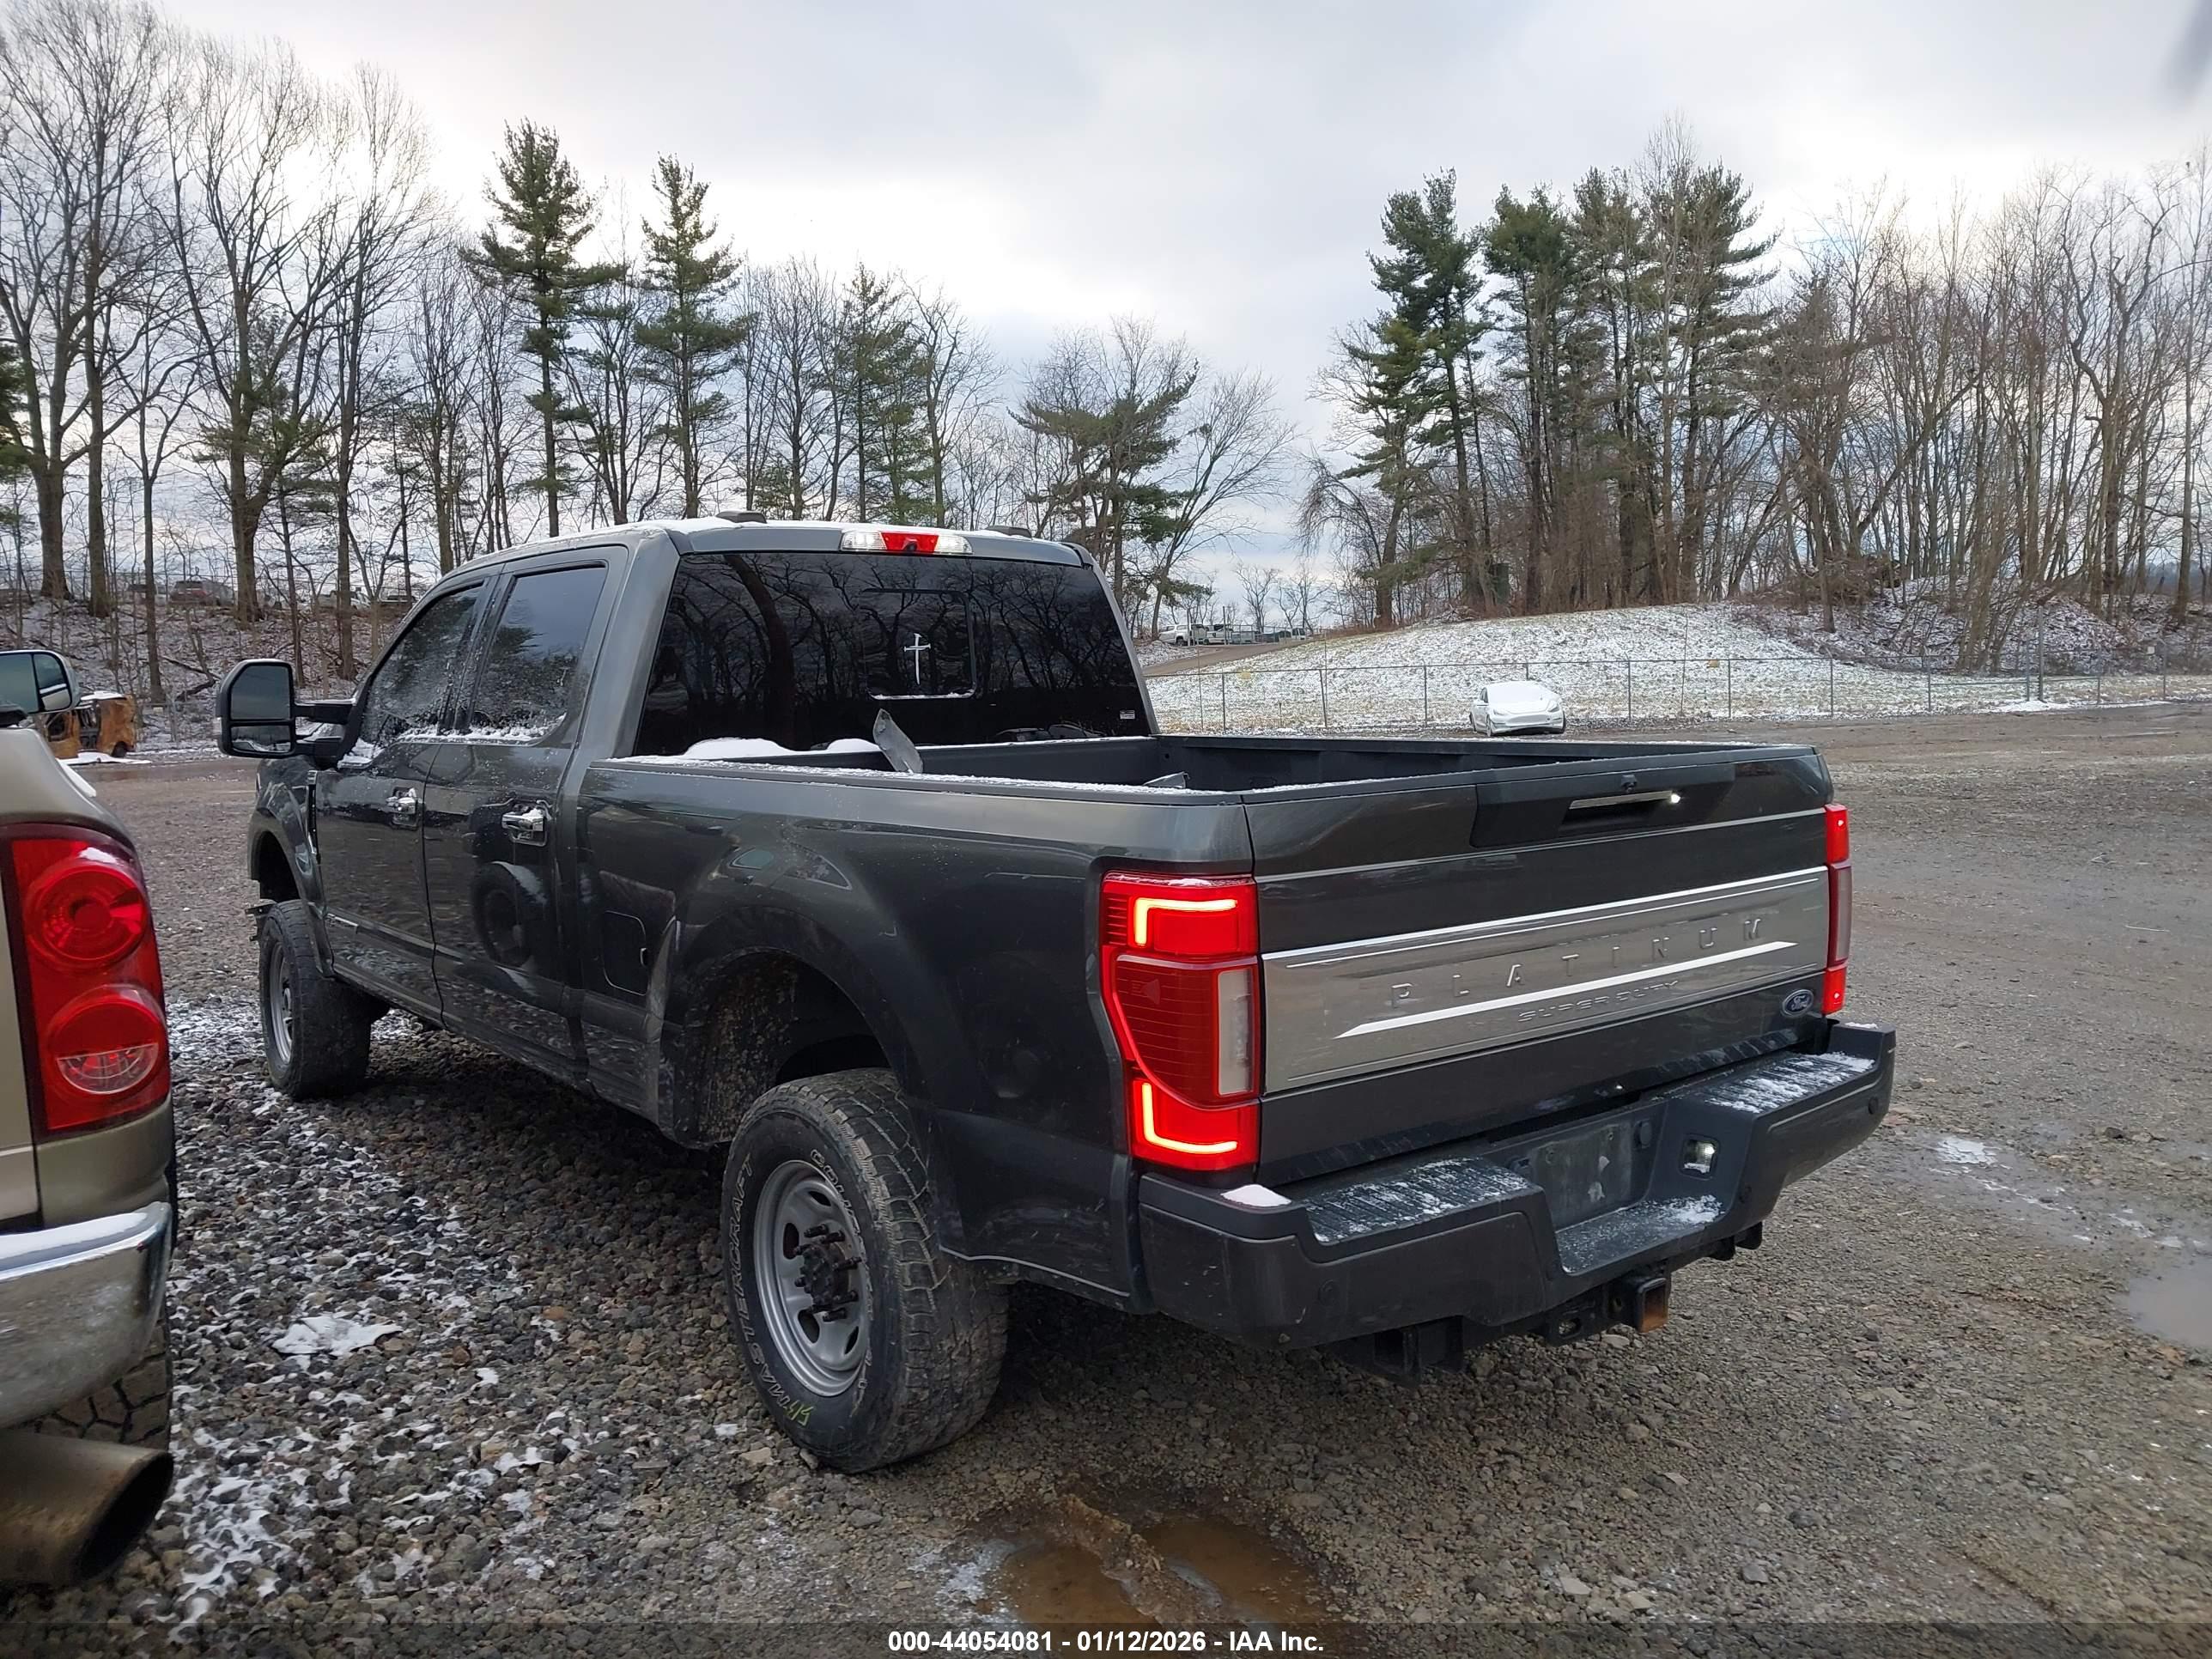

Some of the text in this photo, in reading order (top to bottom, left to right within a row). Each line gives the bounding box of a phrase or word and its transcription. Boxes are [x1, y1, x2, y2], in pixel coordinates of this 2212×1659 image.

[1389, 917, 1762, 1008] PLATINUM
[1517, 980, 1679, 1023] SUPER DUTY
[730, 1153, 791, 1409] MASTERCRAFT
